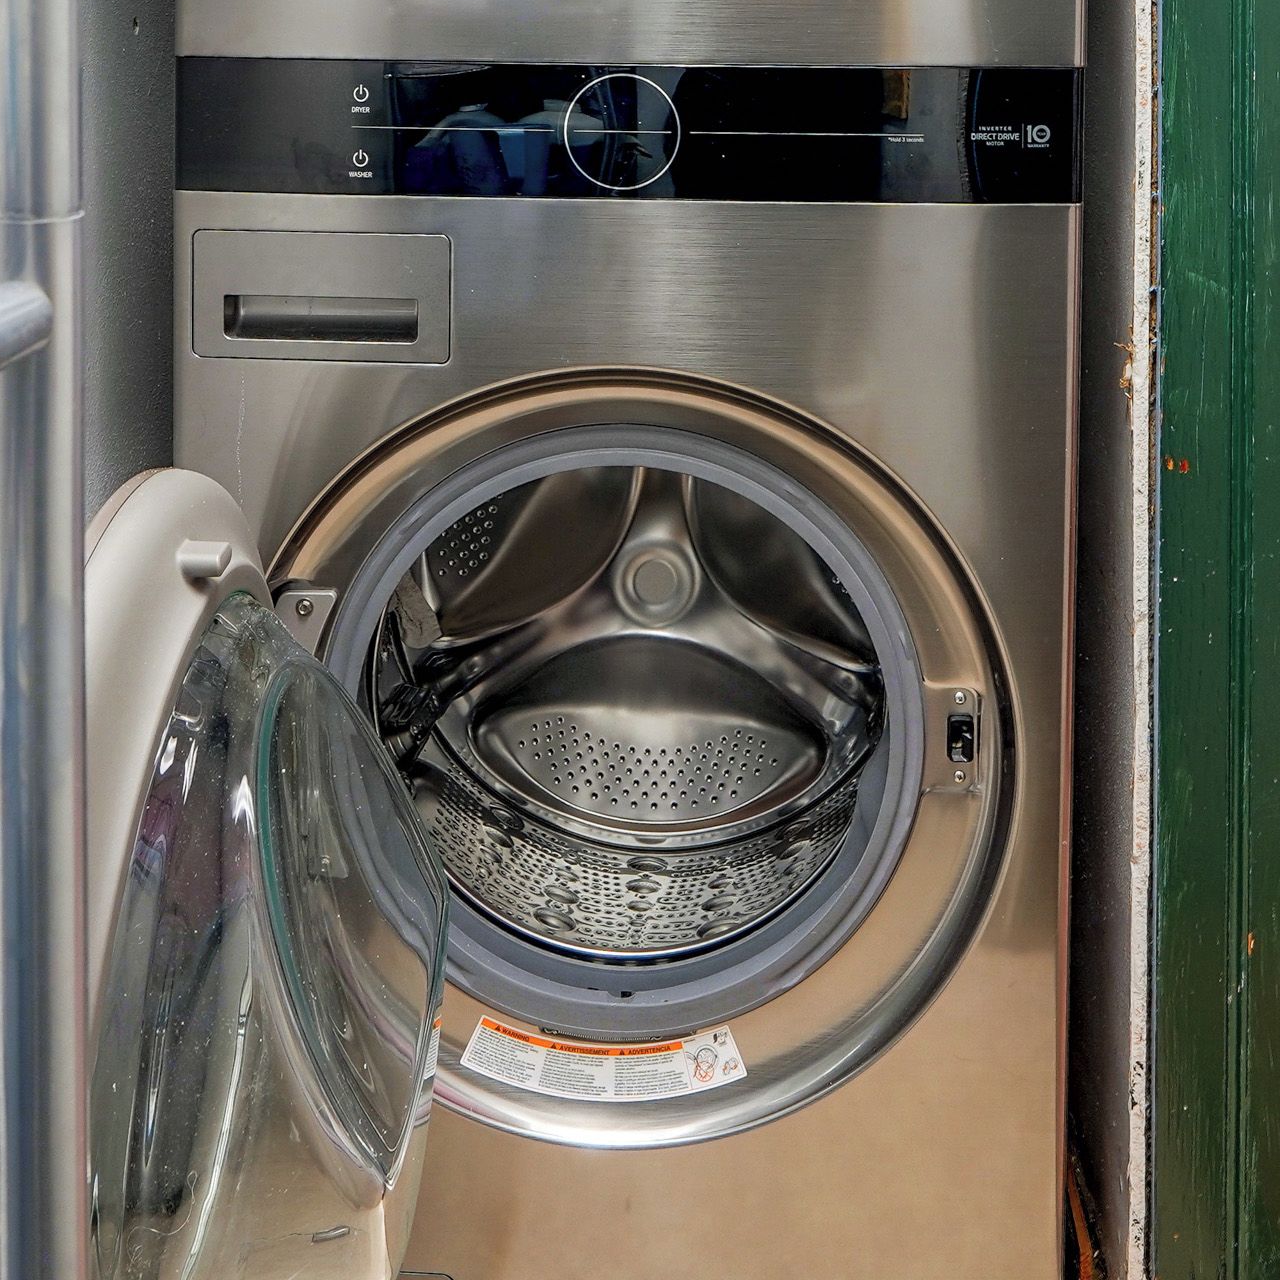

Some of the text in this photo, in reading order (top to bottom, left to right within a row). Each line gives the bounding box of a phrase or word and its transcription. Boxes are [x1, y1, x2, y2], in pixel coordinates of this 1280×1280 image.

[971, 132, 1020, 140] DIRECT DRIVE
[1026, 124, 1051, 143] 10
[501, 1028, 530, 1042] WARNING
[559, 1045, 610, 1056] AVERTISSEMENT
[628, 1045, 671, 1056] ADVERTENCIA
